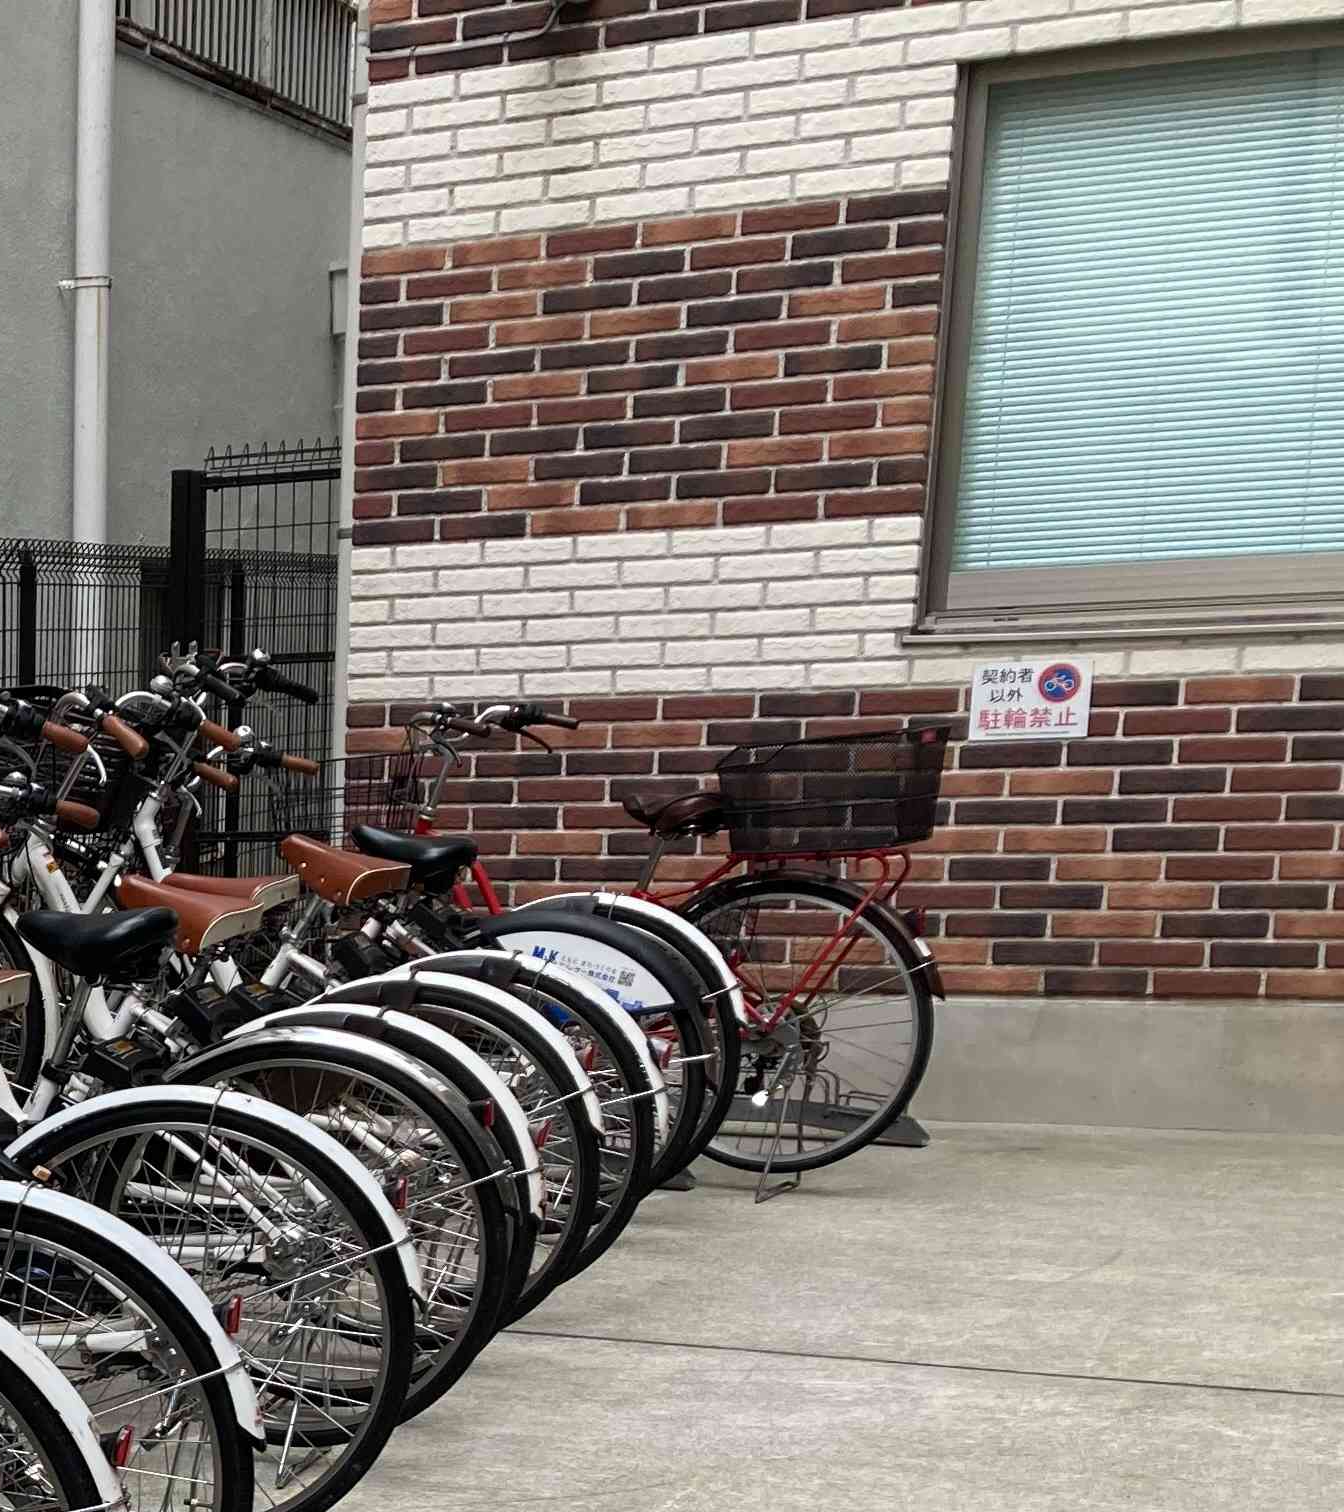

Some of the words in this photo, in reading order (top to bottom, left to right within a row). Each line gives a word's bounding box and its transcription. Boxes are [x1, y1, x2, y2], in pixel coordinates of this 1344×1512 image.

[982, 668, 1034, 685] 契約者
[990, 688, 1024, 704] 以外
[979, 706, 1078, 731] 駐輪禁止
